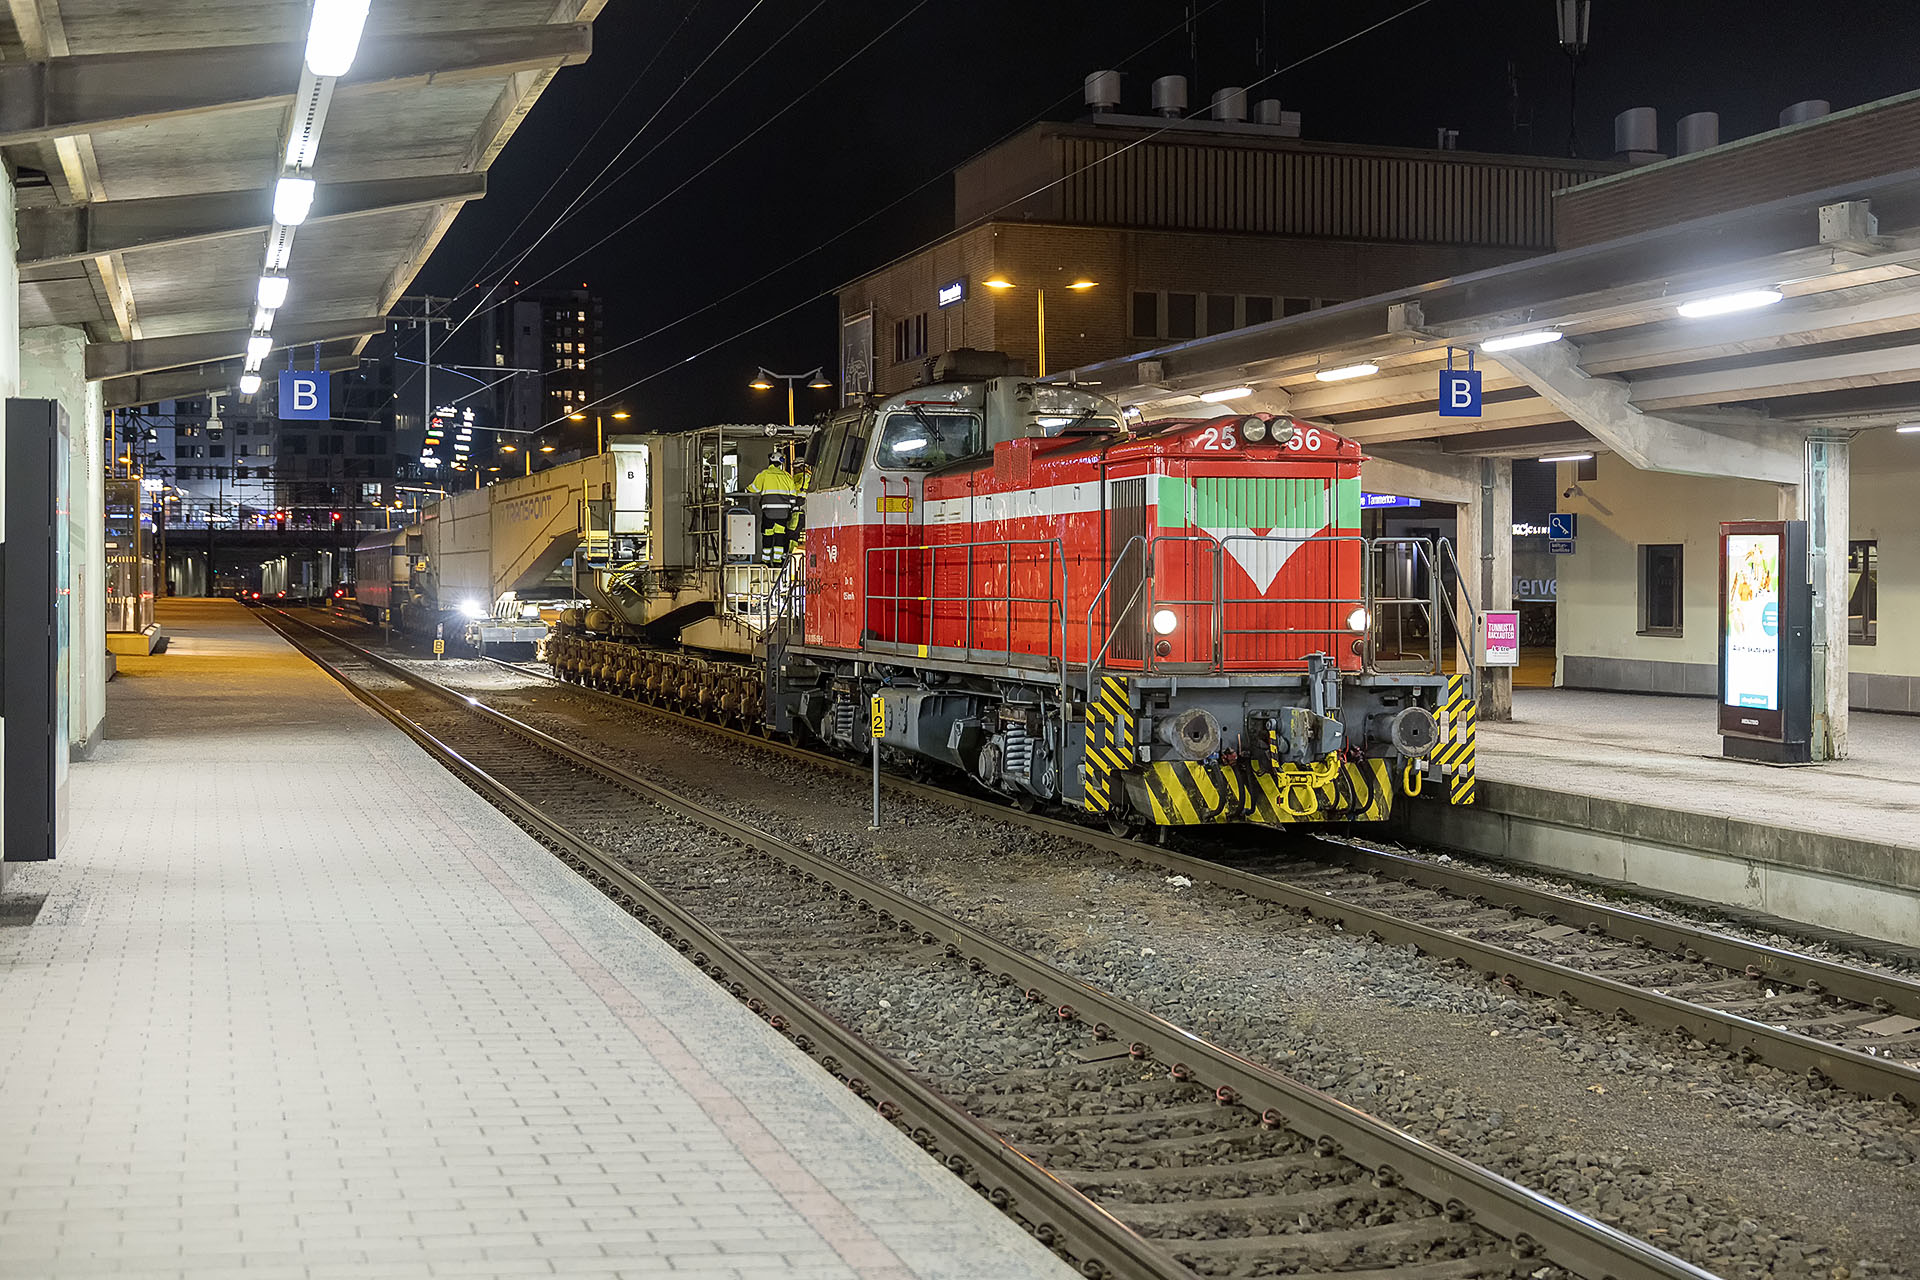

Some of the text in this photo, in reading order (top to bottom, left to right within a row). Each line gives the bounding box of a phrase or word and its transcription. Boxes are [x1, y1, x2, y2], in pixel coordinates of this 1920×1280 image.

[294, 379, 318, 410] B
[1452, 379, 1472, 408] B
[1203, 425, 1321, 451] 25 56
[627, 471, 635, 480] B
[435, 641, 443, 650] B
